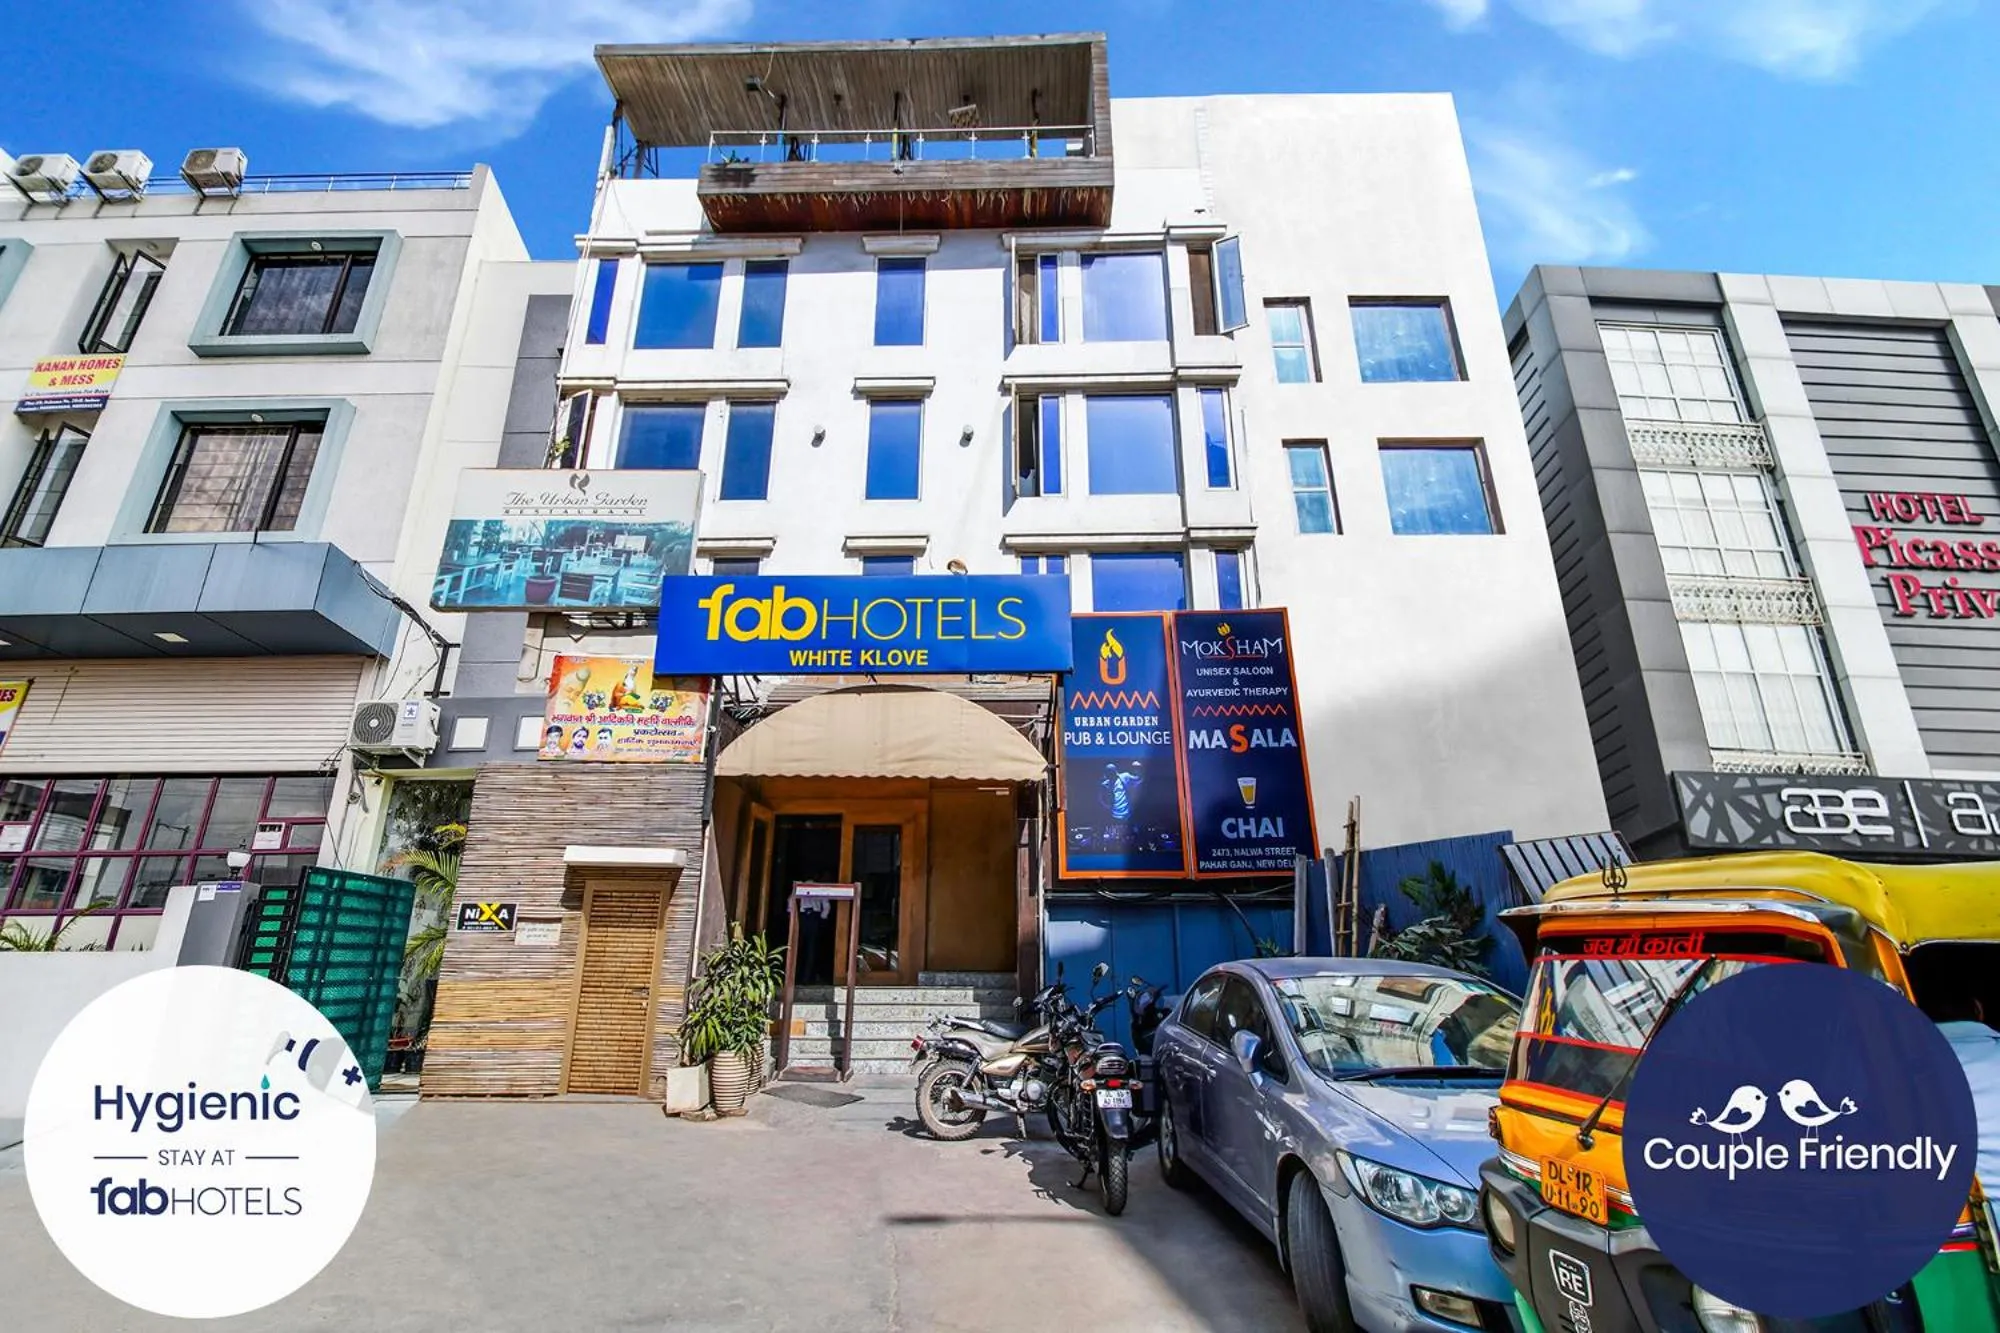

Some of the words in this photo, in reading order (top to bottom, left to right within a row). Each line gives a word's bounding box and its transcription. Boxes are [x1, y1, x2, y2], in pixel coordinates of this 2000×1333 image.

[34, 360, 77, 373] KANAN
[78, 358, 122, 370] HOMES
[48, 377, 57, 386] &
[60, 374, 95, 385] MESS
[503, 492, 534, 506] The
[539, 492, 589, 506] Urban
[592, 492, 648, 506] Garden
[1866, 491, 1985, 525] HOTEL
[1181, 636, 1283, 659] MOKSHAM
[790, 650, 851, 666] WHITE
[860, 649, 928, 666] KLOVE
[1196, 668, 1231, 676] UNISEX
[1233, 666, 1273, 675] SALOON
[1232, 677, 1240, 686] &
[1186, 689, 1241, 697] AYURVEDIC
[1242, 687, 1288, 696] THERAPY
[1074, 717, 1112, 727] URBAN
[1114, 716, 1159, 727] GARDEN
[1064, 732, 1094, 746] PUB
[1095, 732, 1106, 746] &
[1108, 731, 1171, 745] LOUNGE
[1188, 724, 1297, 753] MASALA
[1221, 817, 1284, 839] CHAI
[1234, 847, 1263, 857] NALWA
[1199, 860, 1229, 869] PAHAR
[1256, 860, 1276, 868] NEW
[1583, 939, 1615, 955] जय
[1643, 931, 1706, 955] काली
[1558, 1267, 1587, 1297] RE
